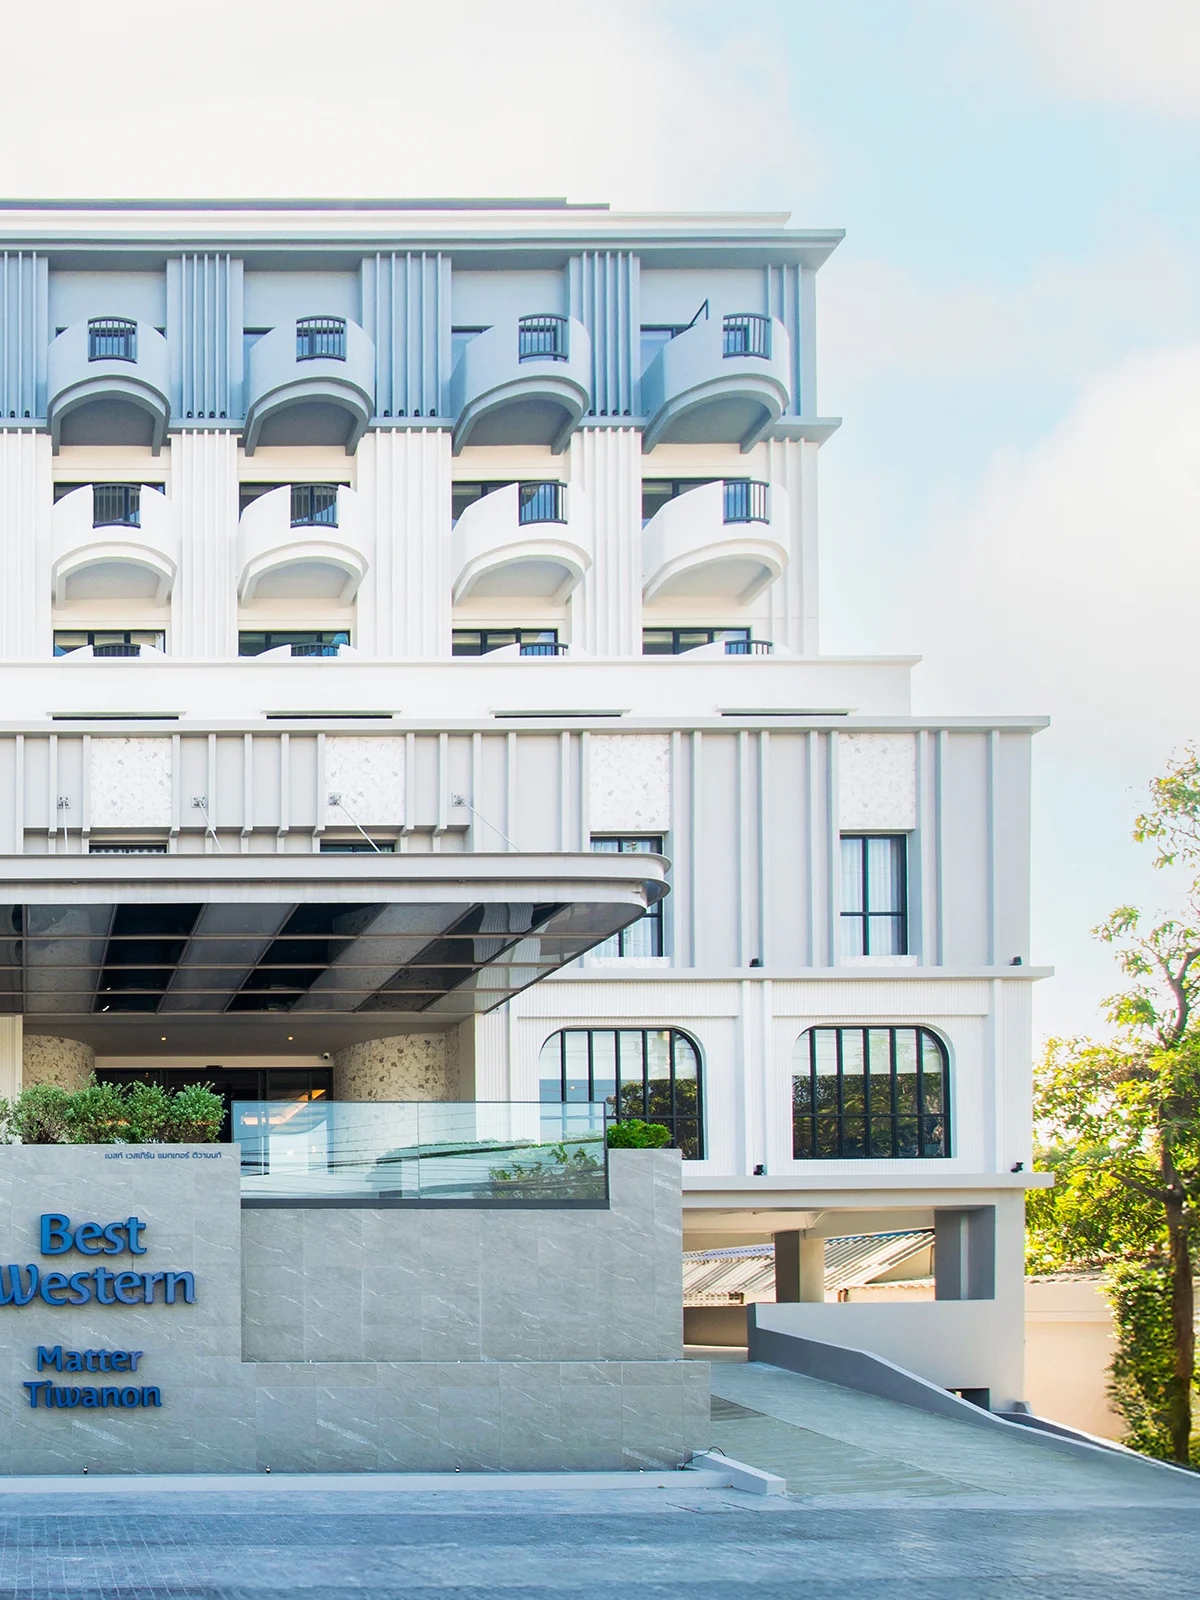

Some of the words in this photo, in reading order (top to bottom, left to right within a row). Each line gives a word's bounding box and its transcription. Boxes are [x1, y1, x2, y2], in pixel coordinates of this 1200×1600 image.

[40, 1213, 147, 1256] Best
[37, 1345, 143, 1372] Matter
[23, 1381, 162, 1409] Tiwanon
